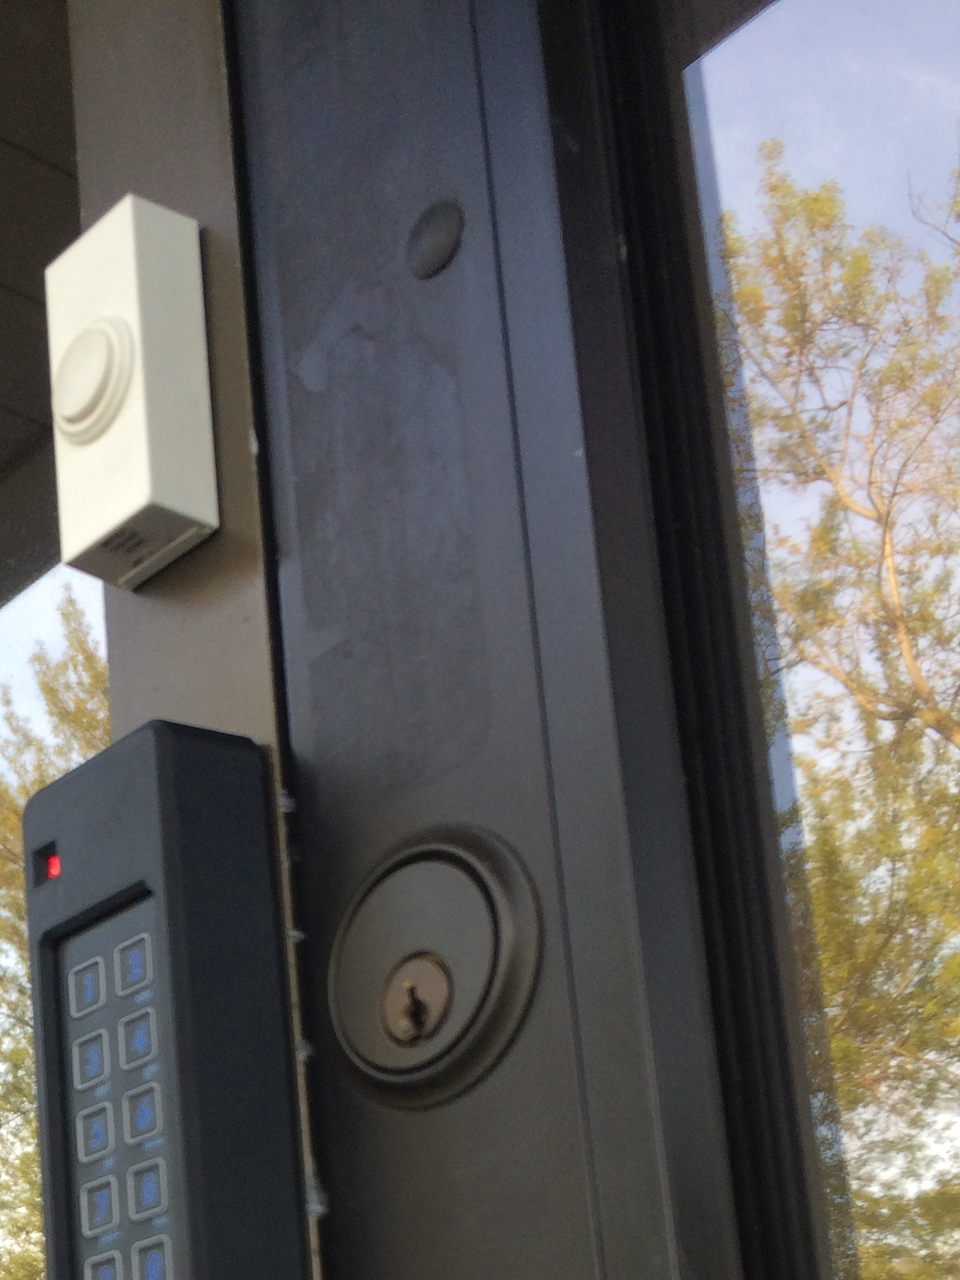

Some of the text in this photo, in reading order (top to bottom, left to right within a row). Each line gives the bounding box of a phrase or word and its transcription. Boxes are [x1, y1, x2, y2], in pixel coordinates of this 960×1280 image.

[126, 950, 144, 982] 2
[85, 1022, 149, 1078] 3 4
[89, 1116, 106, 1149] 5
[136, 1098, 153, 1130] 6
[94, 1173, 158, 1221] 7 8
